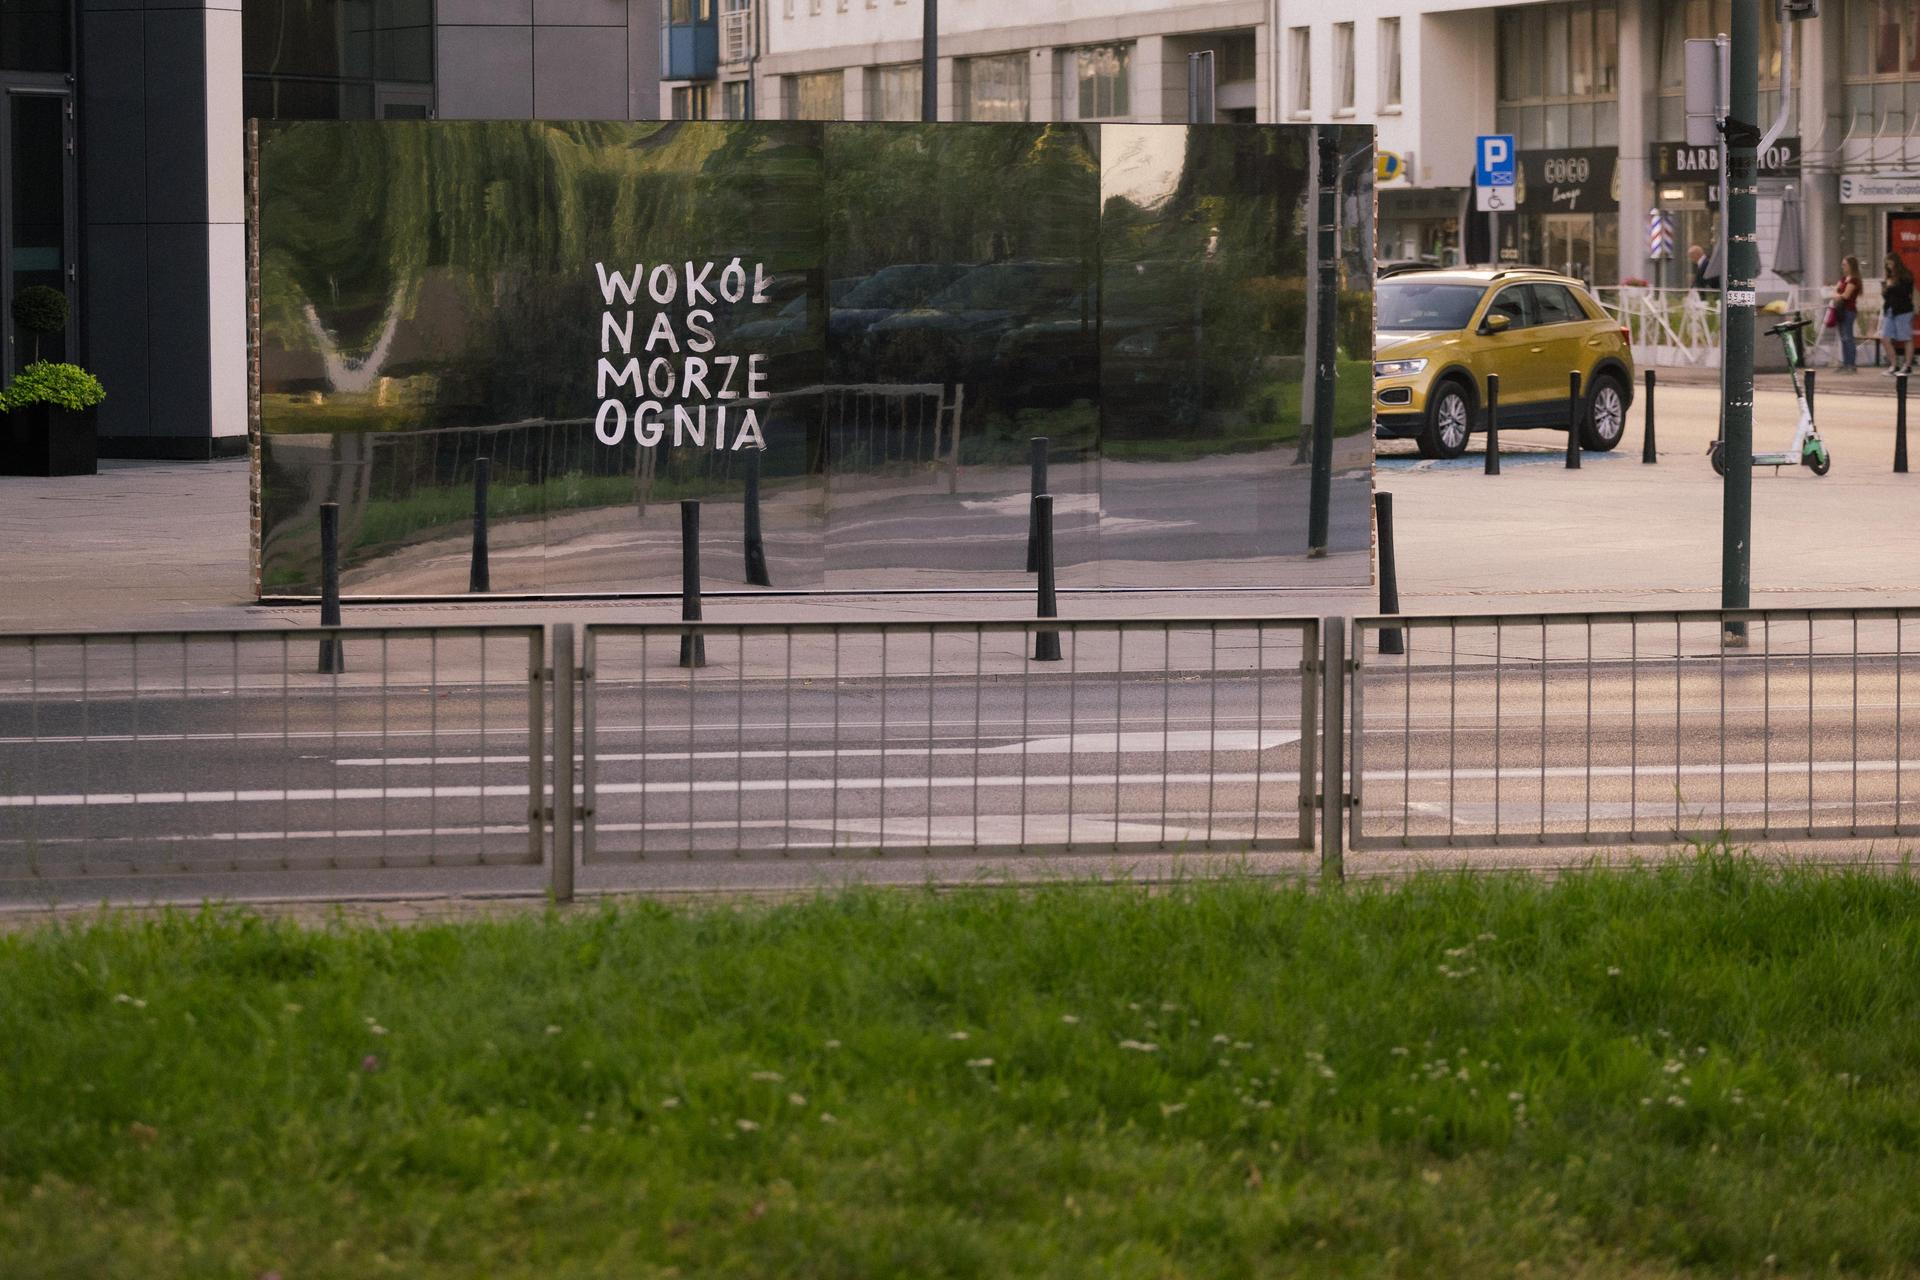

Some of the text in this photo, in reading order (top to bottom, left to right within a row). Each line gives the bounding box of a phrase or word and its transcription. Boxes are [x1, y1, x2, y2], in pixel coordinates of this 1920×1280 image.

[1484, 139, 1508, 172] P
[1544, 157, 1590, 184] COCO
[1676, 149, 1719, 170] BARB
[595, 257, 776, 307] WOKÓŁ
[601, 309, 716, 354] NAS
[597, 353, 771, 400] MORZE
[594, 398, 768, 452] OGNIA
